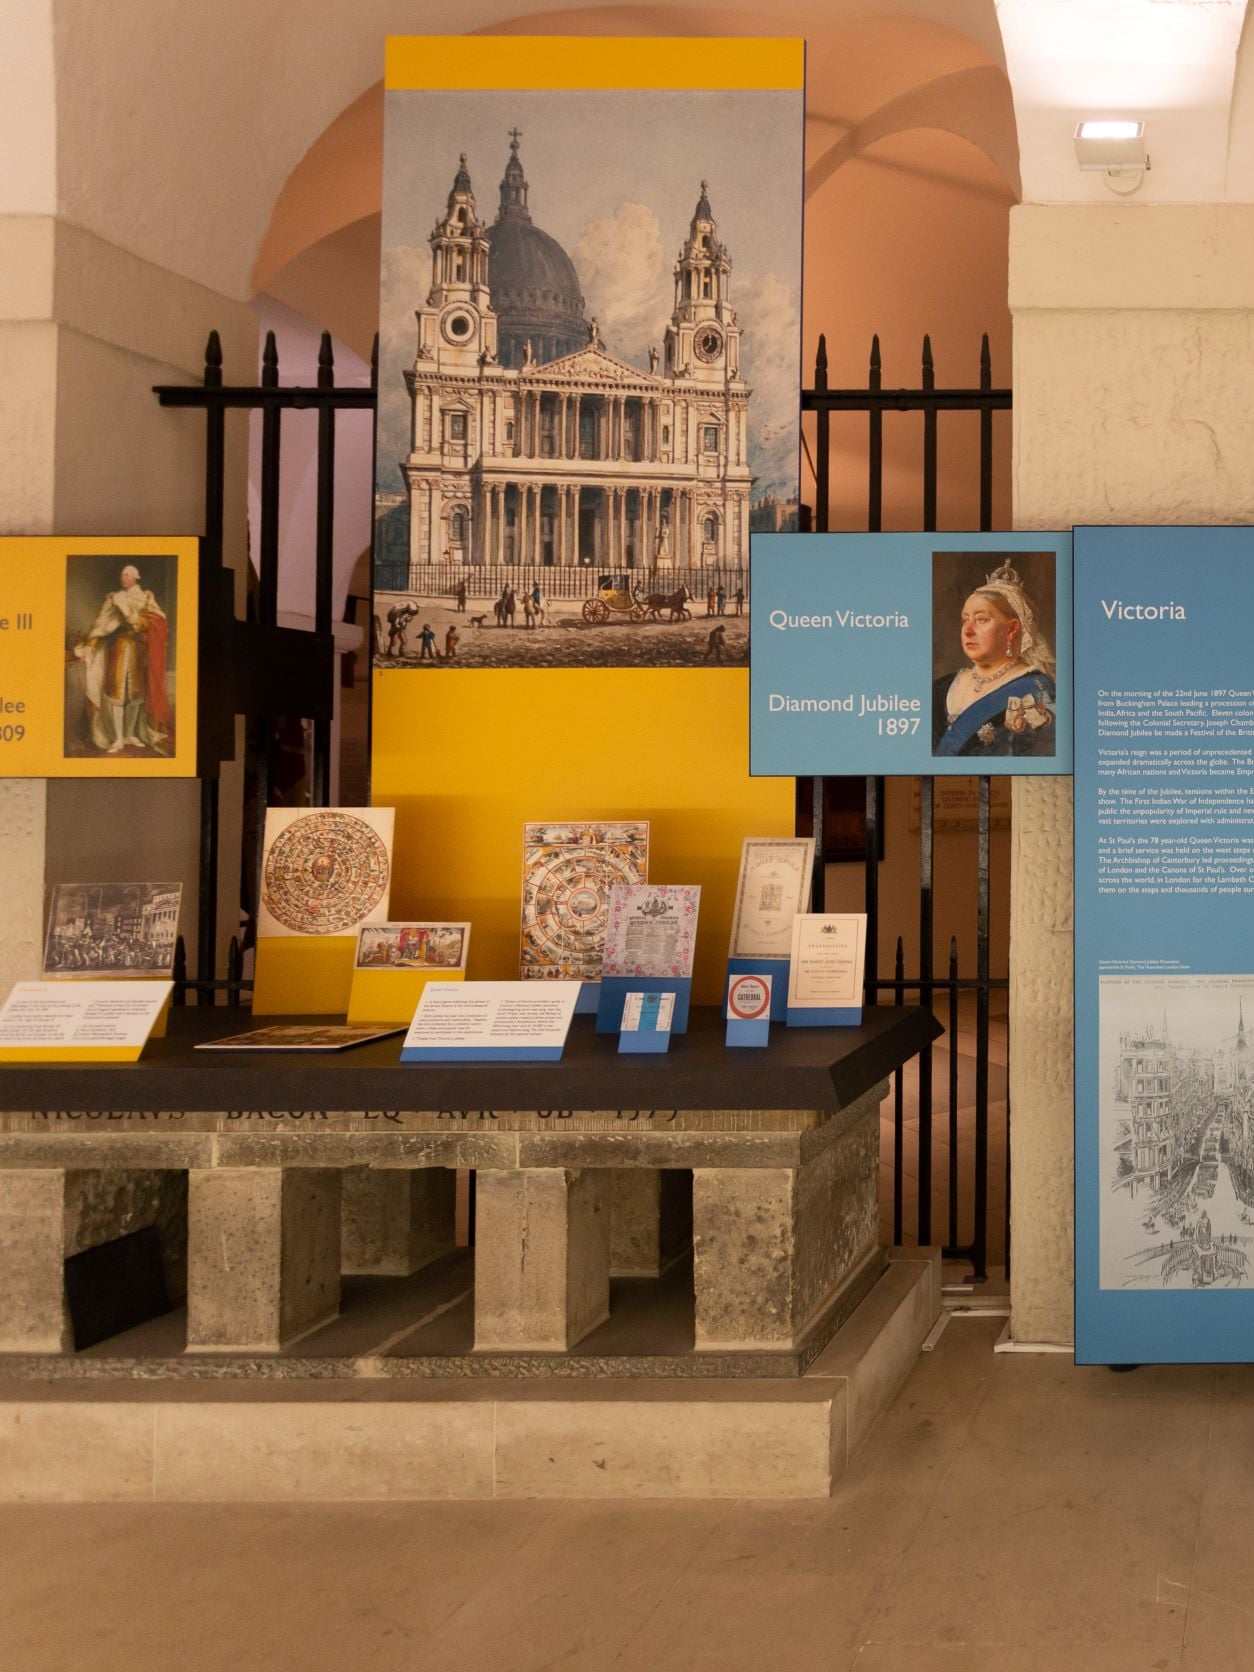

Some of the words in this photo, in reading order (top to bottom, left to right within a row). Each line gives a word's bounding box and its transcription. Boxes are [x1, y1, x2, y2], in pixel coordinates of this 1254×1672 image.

[1101, 600, 1186, 620] Victoria
[17, 613, 32, 630] III
[769, 610, 832, 630] Queen
[835, 610, 909, 627] Victoria
[1124, 690, 1152, 699] morning
[1194, 690, 1208, 699] June
[1228, 690, 1251, 699] Queen
[769, 694, 853, 712] Diamond
[858, 694, 921, 717] Jubilee
[1116, 699, 1155, 708] Buckingham
[1180, 699, 1203, 708] leading
[1210, 699, 1246, 708] procession
[878, 718, 921, 736] 1897
[1098, 719, 1128, 728] following
[1206, 719, 1228, 728] Joseph
[1098, 728, 1129, 736] Diamond
[1130, 728, 1152, 738] Jubilee
[1154, 728, 1162, 736] be
[1164, 728, 1182, 736] made
[1190, 728, 1214, 736] Festival
[1217, 728, 1224, 736] of
[1226, 728, 1236, 736] the
[1131, 748, 1147, 757] reign
[1169, 748, 1192, 757] period
[1202, 748, 1252, 757] unprecedented
[1098, 758, 1130, 767] expanded
[1132, 758, 1171, 767] dramatically
[1142, 886, 1159, 895] steps
[1219, 886, 1241, 895] people
